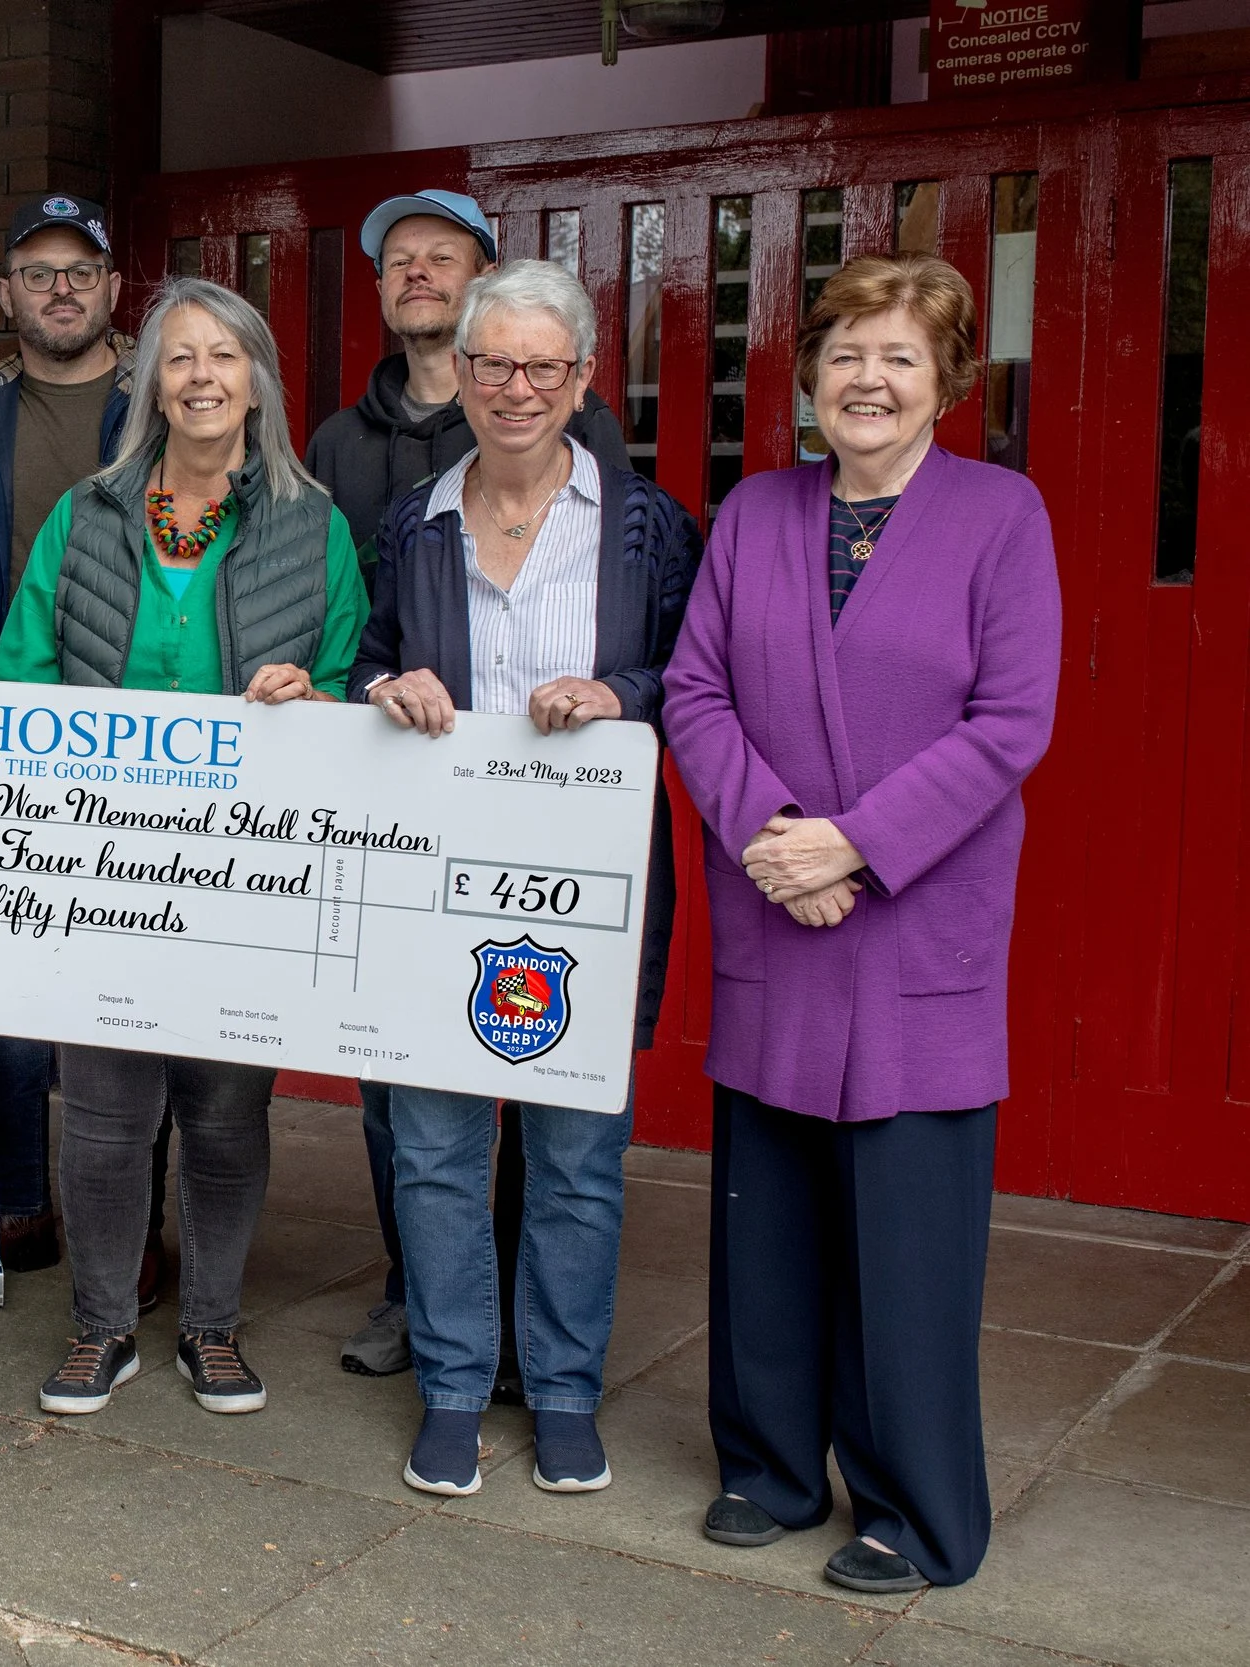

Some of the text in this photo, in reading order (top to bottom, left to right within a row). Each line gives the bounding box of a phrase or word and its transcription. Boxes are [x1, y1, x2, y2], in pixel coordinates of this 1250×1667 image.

[980, 5, 1049, 26] NOTICE
[948, 22, 1081, 49] Concealed CCTV
[936, 52, 1002, 69] cameras
[1006, 44, 1066, 64] operate
[953, 63, 1073, 86] these premises
[5, 759, 47, 778] THE
[54, 762, 117, 782] GOOD
[123, 768, 238, 790] SHEPHERD
[453, 760, 623, 788] Date 23rd May 2023
[65, 788, 215, 834] Memorial
[224, 801, 299, 841] Hall
[307, 809, 433, 852] Farndon
[95, 841, 235, 889] hundred
[246, 864, 312, 895] and
[328, 858, 345, 942] Account payee
[454, 872, 581, 915] £ 450
[65, 896, 188, 937] pounds
[486, 953, 562, 974] FARNDON
[98, 993, 135, 1005] Cheque No
[219, 1007, 279, 1022] Branch Sort Code
[478, 1011, 558, 1033] SOAPBOX
[339, 1021, 379, 1034] Account No
[492, 1030, 542, 1047] DERBY
[506, 1045, 525, 1053] 2022
[533, 1065, 546, 1075] Reg
[546, 1067, 569, 1078] Charity
